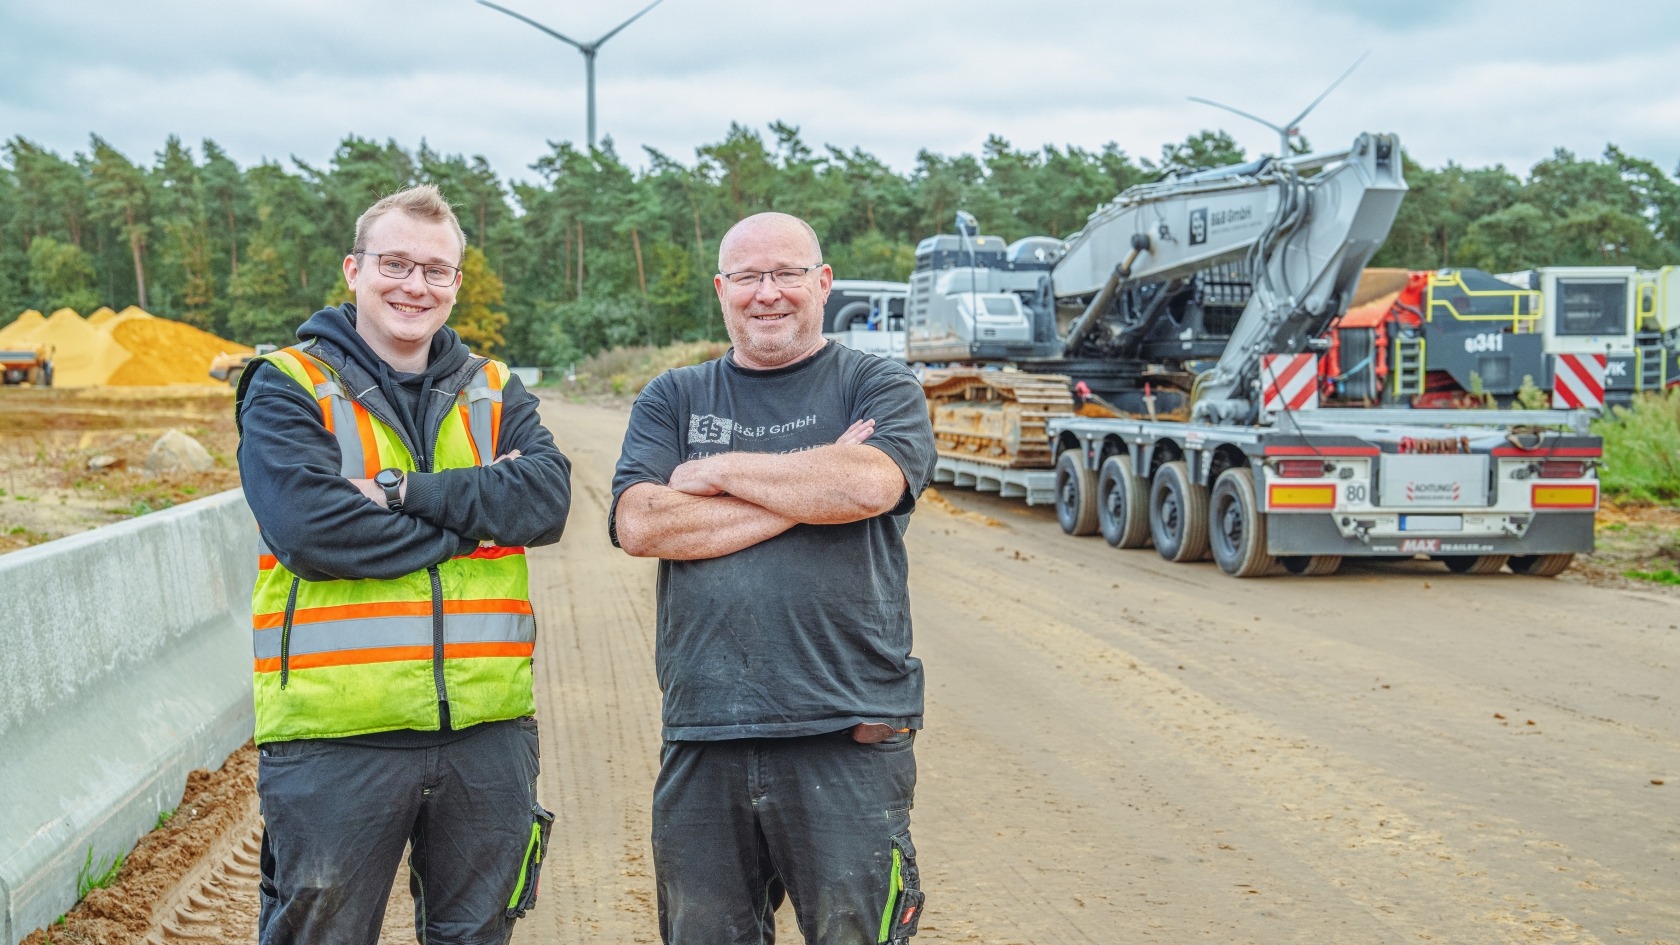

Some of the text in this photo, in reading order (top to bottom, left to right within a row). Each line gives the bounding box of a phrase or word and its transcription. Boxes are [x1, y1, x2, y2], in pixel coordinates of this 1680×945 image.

[1227, 204, 1252, 223] GmbH
[733, 421, 766, 437] B&B
[769, 414, 817, 434] GmbH
[1346, 485, 1366, 502] 80
[1415, 483, 1452, 493] ACHTUNG
[1402, 539, 1437, 552] MAX
